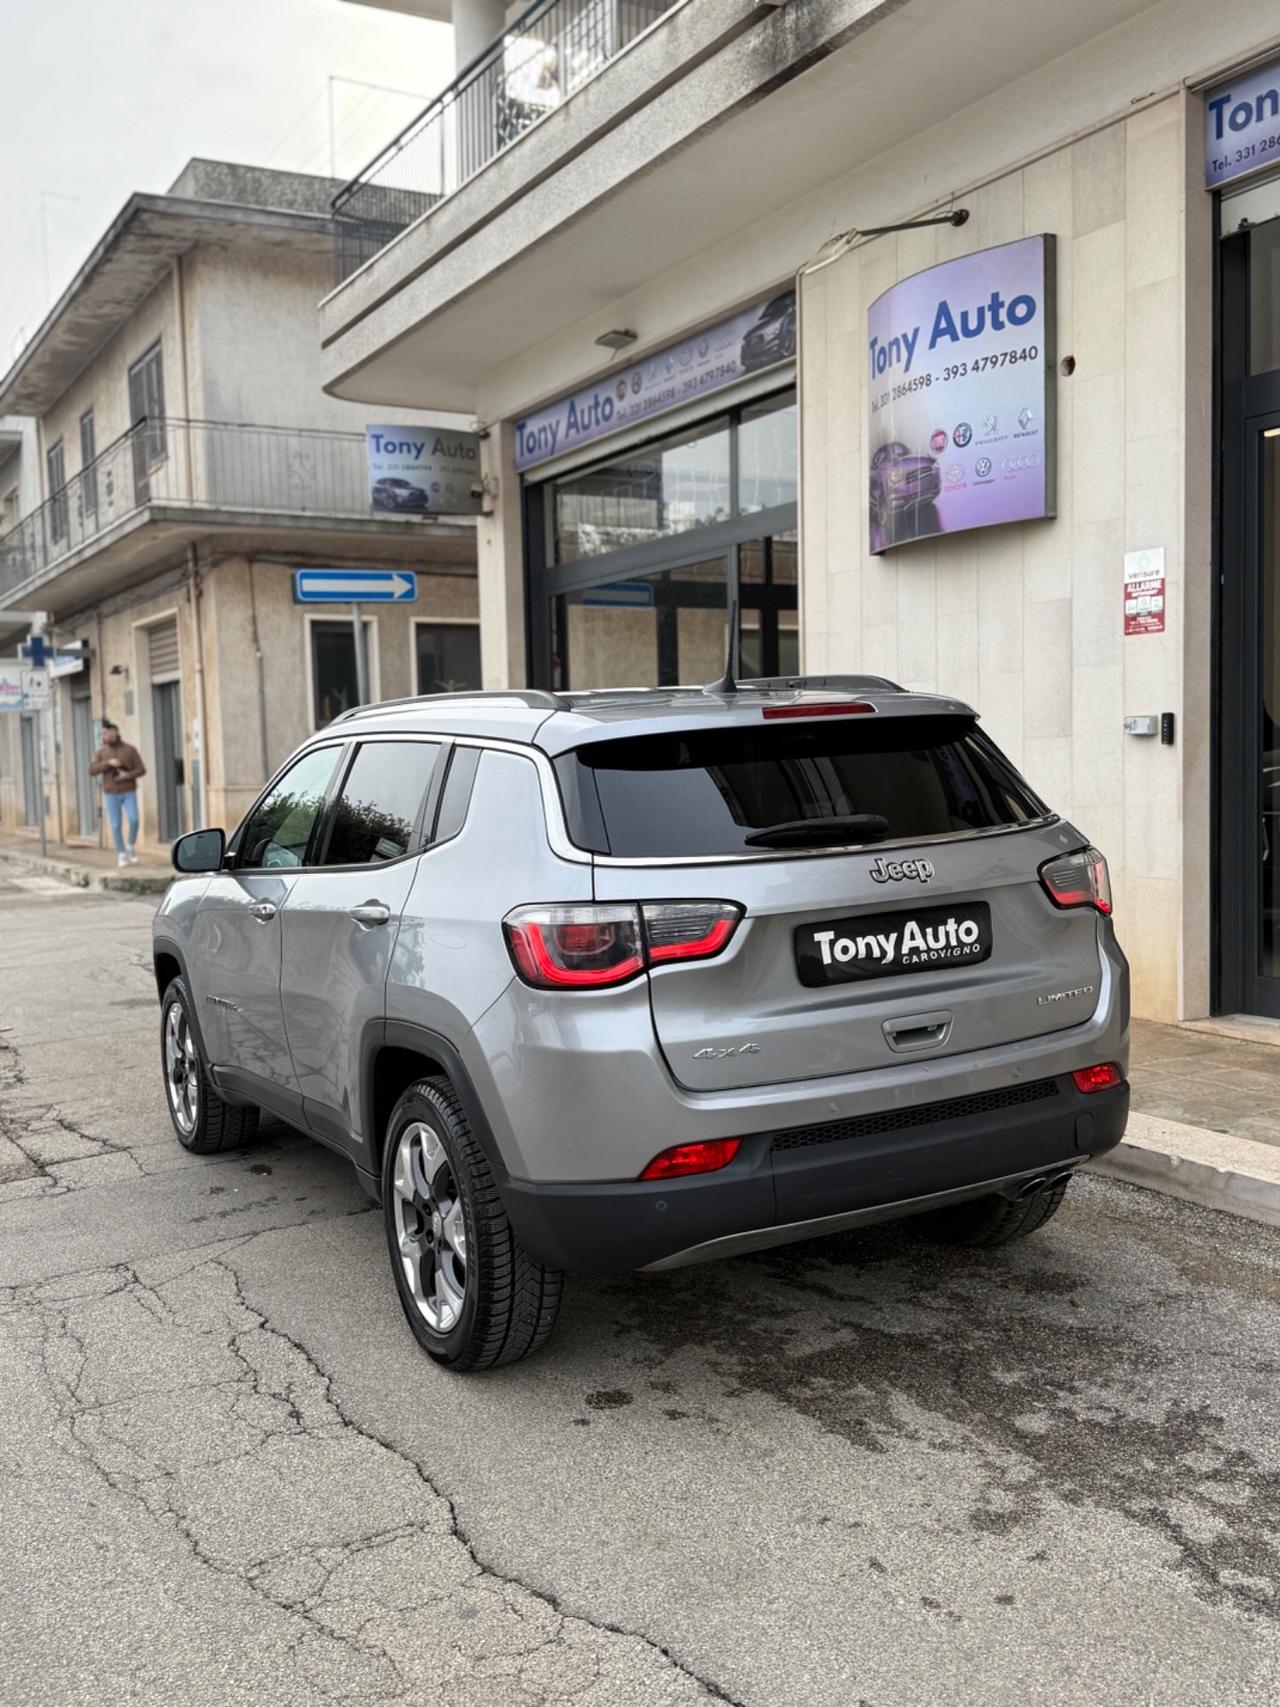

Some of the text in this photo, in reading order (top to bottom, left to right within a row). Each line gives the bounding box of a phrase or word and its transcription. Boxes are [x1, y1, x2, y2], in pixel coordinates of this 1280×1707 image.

[1208, 89, 1279, 140] Ton
[1211, 155, 1232, 172] Tel.
[1235, 144, 1256, 162] 331
[870, 292, 1037, 380] Tony Auto
[892, 373, 932, 401] 2864598
[943, 362, 968, 381] 393
[971, 345, 1038, 373] 4797840
[515, 394, 614, 458] Tony Auto
[371, 433, 476, 461] Tony Auto
[1126, 580, 1163, 593] ALLARME
[869, 858, 935, 882] Jeep
[813, 918, 979, 965] Tony Auto
[902, 943, 981, 965] CAROVIGNO
[1036, 985, 1093, 1005] LIMITED
